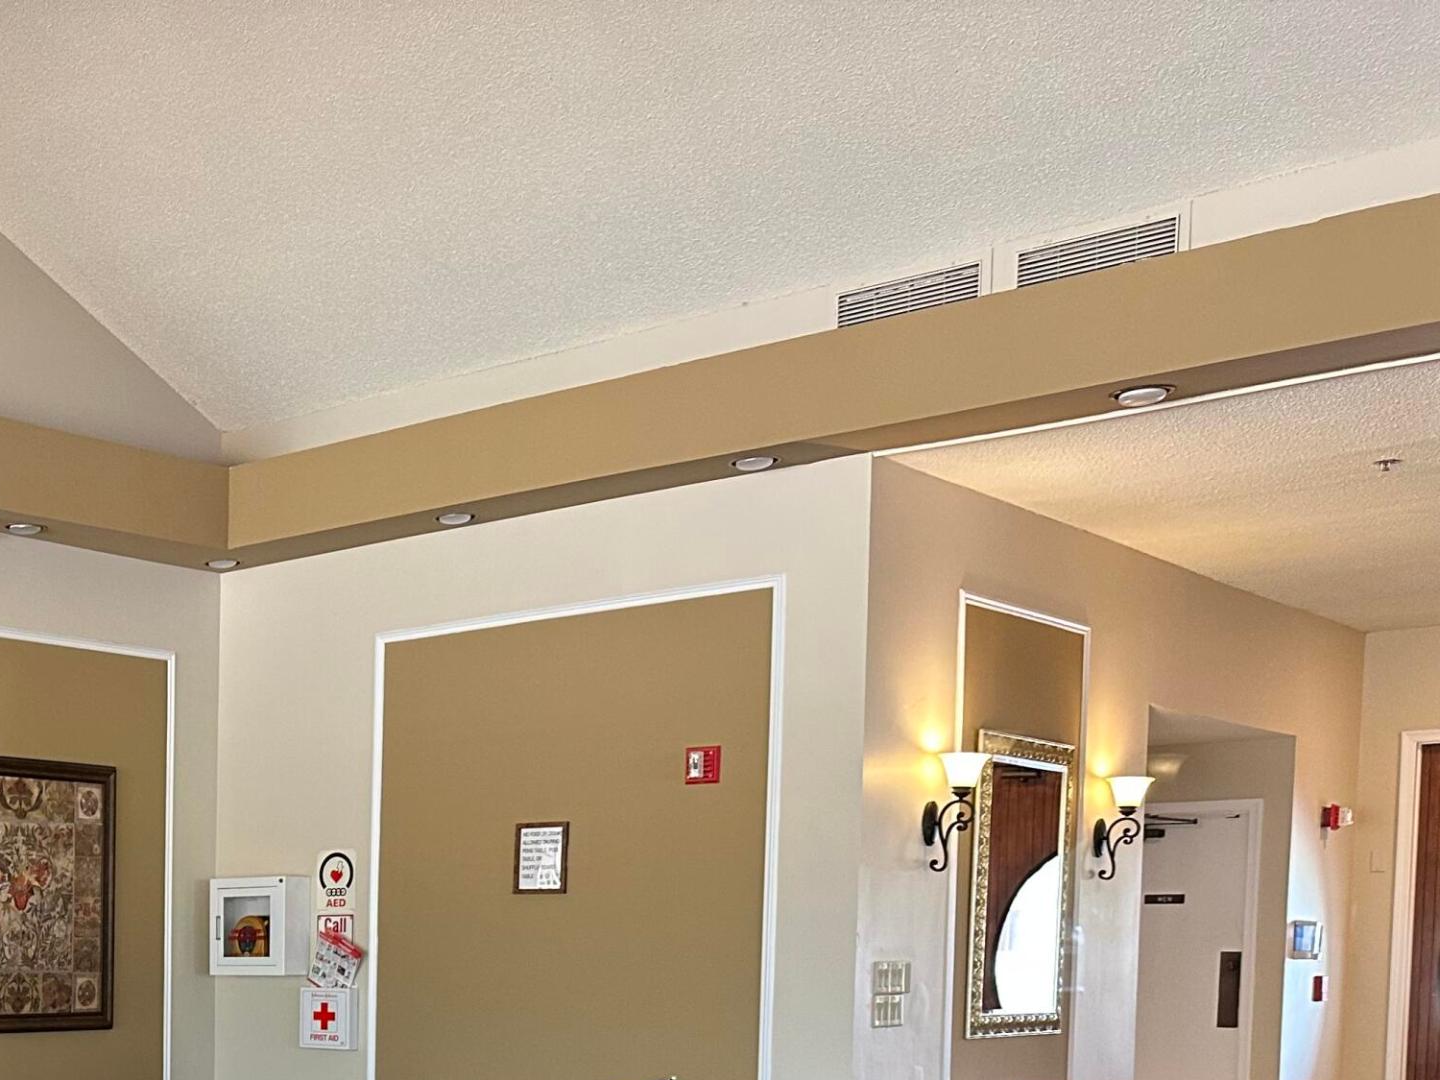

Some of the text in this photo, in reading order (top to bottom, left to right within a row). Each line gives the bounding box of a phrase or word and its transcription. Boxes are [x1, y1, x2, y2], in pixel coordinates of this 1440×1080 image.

[326, 898, 346, 907] AED
[324, 917, 347, 933] Call
[328, 1034, 339, 1042] AID
